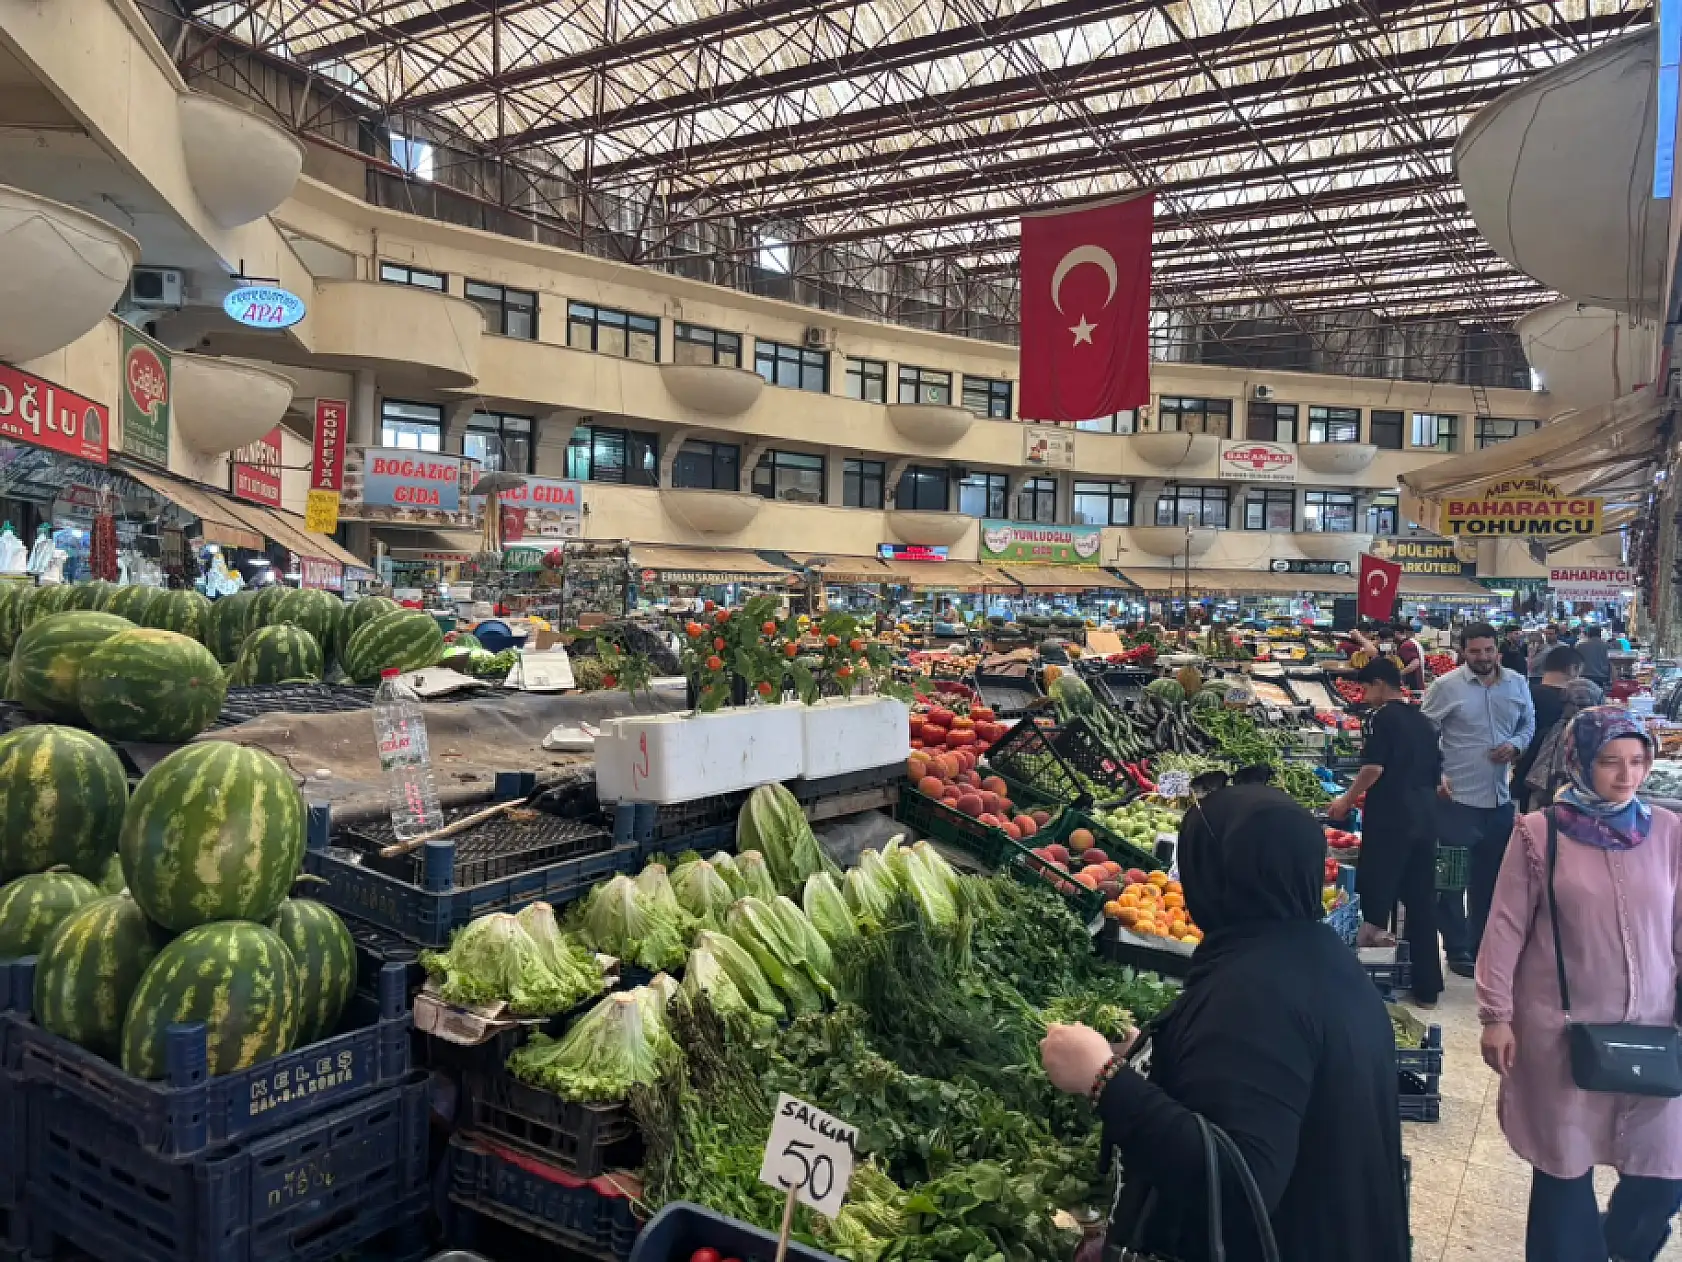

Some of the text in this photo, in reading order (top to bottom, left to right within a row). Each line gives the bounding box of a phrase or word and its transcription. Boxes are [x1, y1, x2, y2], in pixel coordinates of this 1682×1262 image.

[242, 303, 283, 322] APA
[371, 456, 458, 485] BOĞAZİÇİ
[393, 485, 440, 505] GIDA
[533, 484, 575, 504] GIDA
[1484, 479, 1557, 500] MEVSİM
[1448, 520, 1594, 534] TOHUMCU
[1551, 570, 1629, 582] BAHARATÇI
[778, 1140, 834, 1200] 50
